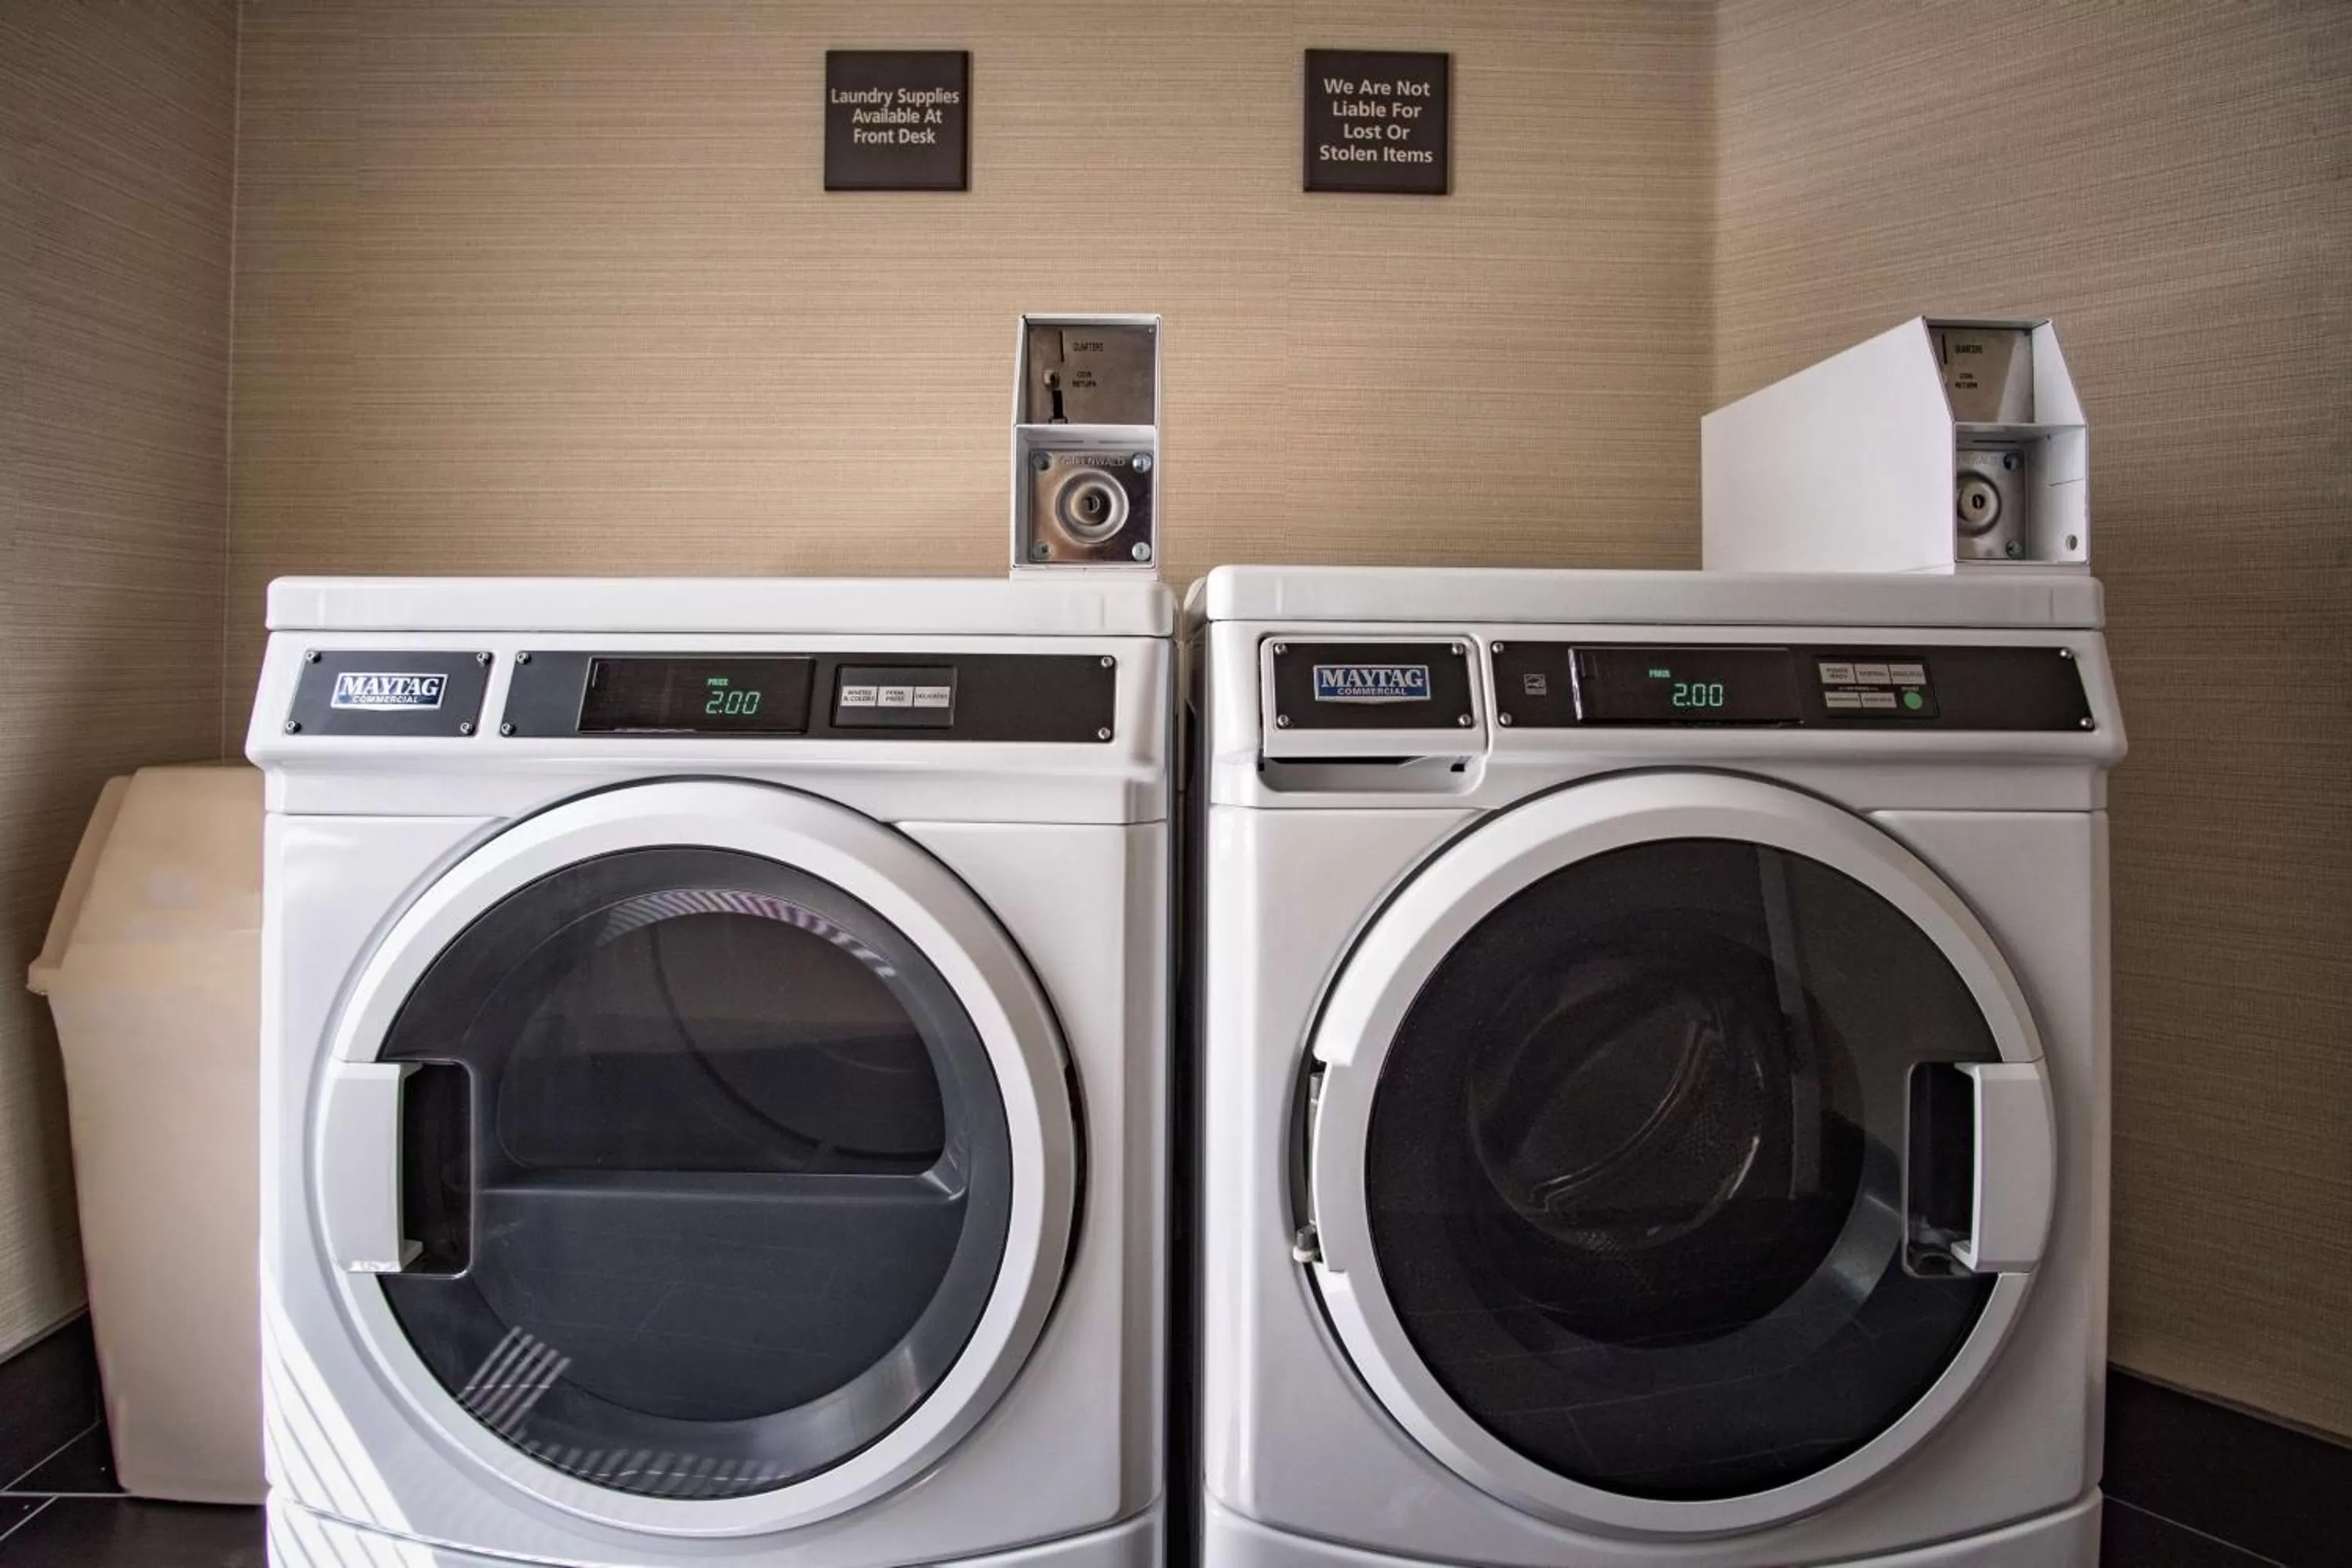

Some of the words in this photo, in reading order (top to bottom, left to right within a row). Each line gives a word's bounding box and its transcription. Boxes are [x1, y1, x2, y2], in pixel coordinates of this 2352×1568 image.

[1323, 78, 1354, 94] We
[1359, 79, 1392, 95] Are
[1396, 80, 1431, 96] Not
[831, 88, 893, 107] Laundry
[897, 88, 960, 107] Supplies
[852, 107, 920, 123] Available
[924, 108, 942, 123] At
[1333, 100, 1387, 117] Liable
[1392, 102, 1422, 118] For
[854, 129, 895, 143] Front
[898, 128, 935, 143] Desk
[1344, 123, 1383, 140] Lost
[1387, 125, 1410, 140] Or
[1319, 144, 1377, 162] Stolen
[1383, 147, 1434, 163] Items
[341, 676, 439, 696] MAYTAG
[1321, 669, 1424, 688] MAYTAG
[352, 695, 419, 703] COMMERCIAL
[1337, 687, 1407, 695] COMMERCIAL
[1672, 683, 1723, 706] 2.00
[706, 691, 760, 714] 2.00
